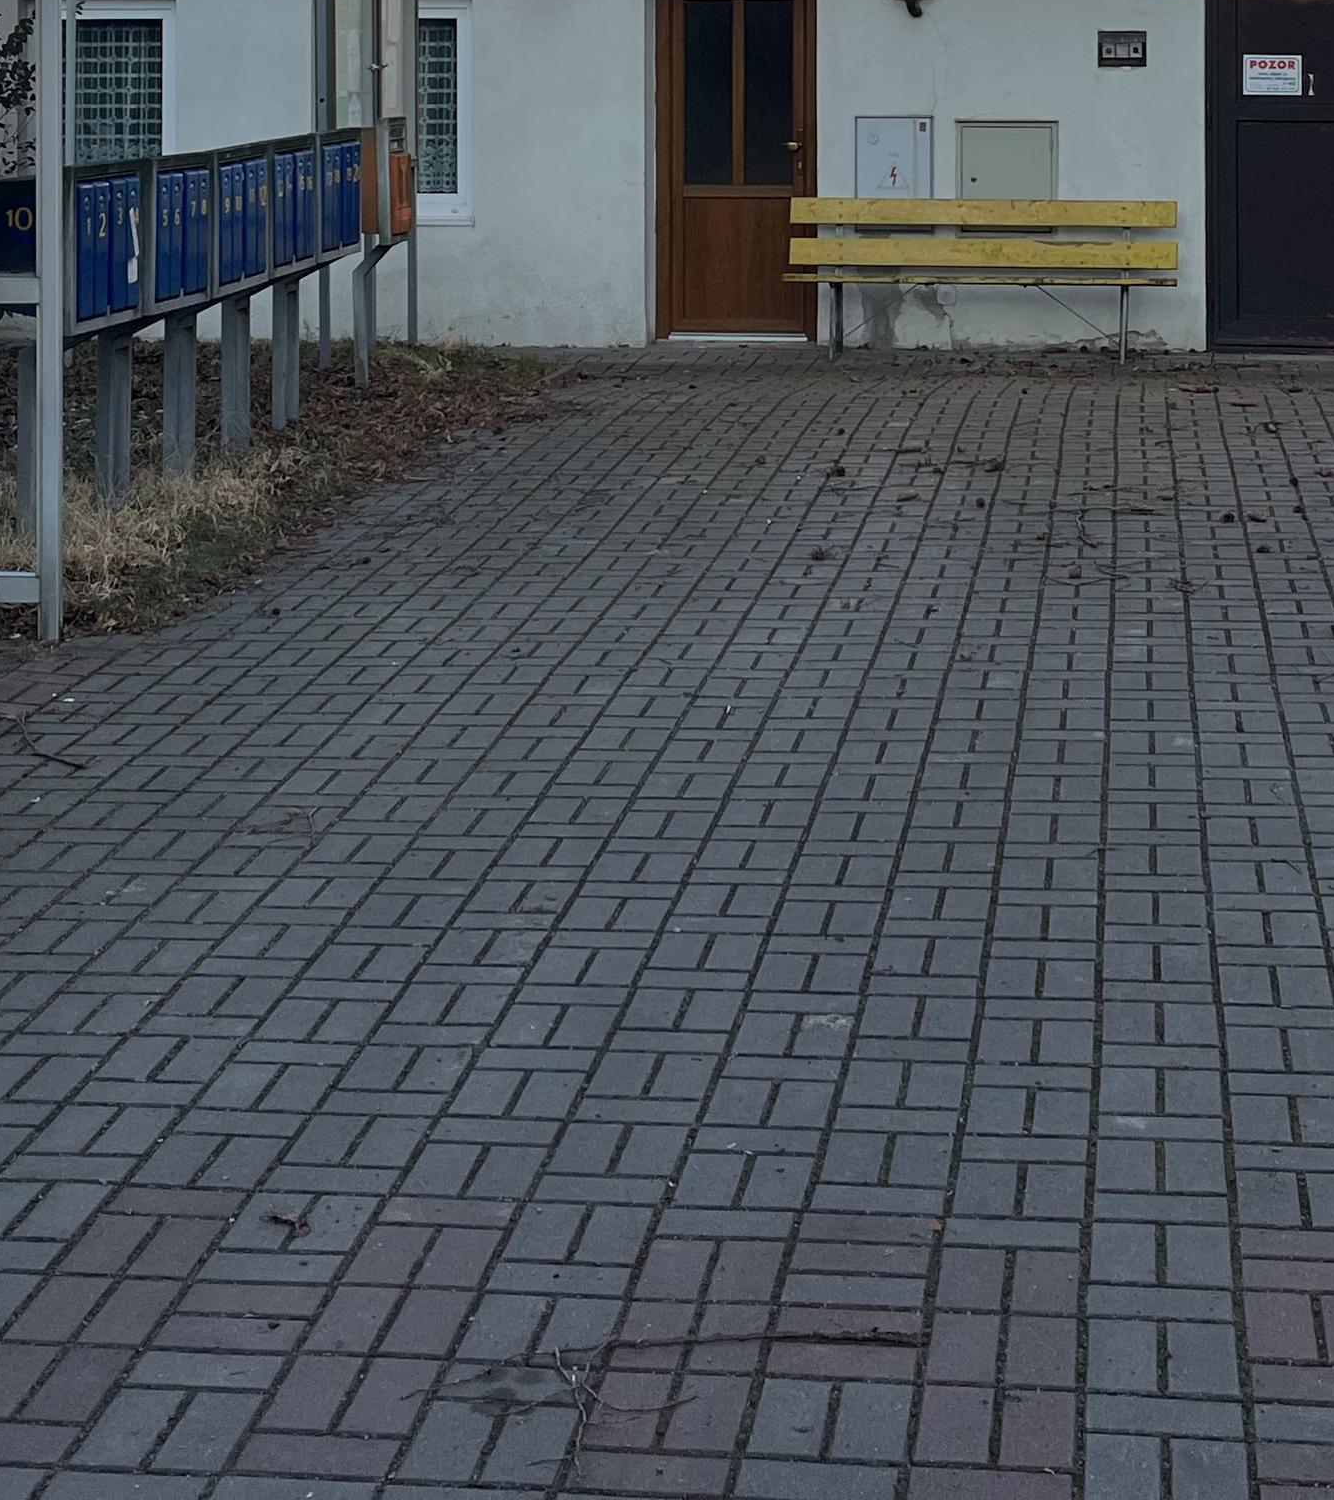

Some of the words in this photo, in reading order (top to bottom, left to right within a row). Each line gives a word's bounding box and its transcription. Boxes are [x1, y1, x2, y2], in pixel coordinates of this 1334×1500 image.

[1249, 60, 1296, 70] POZOR
[116, 207, 124, 225] 3
[173, 208, 181, 226] 6
[190, 200, 197, 218] 7
[5, 206, 34, 231] 10
[87, 216, 92, 236] 1
[98, 212, 107, 238] 2
